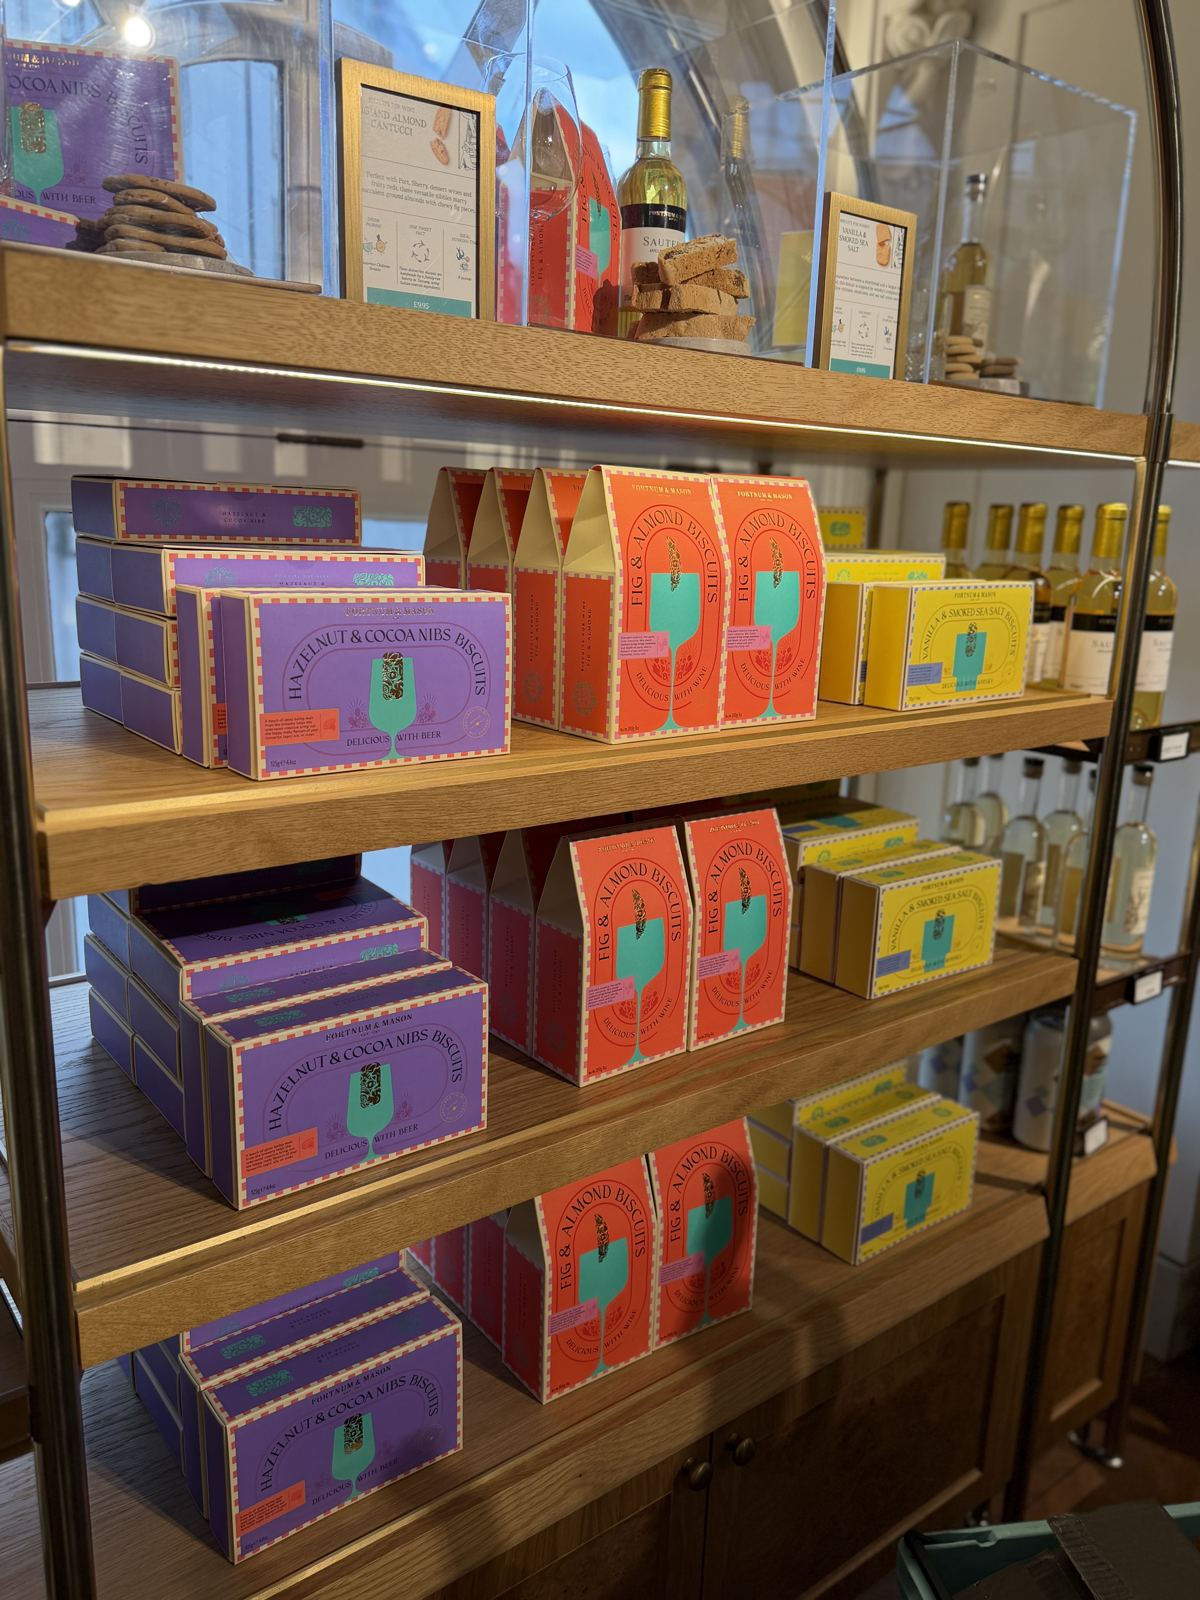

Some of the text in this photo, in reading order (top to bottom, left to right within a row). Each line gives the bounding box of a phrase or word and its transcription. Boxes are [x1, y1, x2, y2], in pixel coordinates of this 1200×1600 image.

[370, 119, 413, 136] CANTUCCI
[371, 109, 427, 128] AND ALMOND
[42, 192, 69, 202] WITH
[72, 194, 97, 204] BEER
[839, 235, 869, 247] SMOKED SEA
[842, 227, 863, 238] VANILLA
[847, 245, 860, 253] SALT
[632, 484, 665, 493] FORTNUM
[670, 487, 693, 495] MASON
[737, 490, 768, 498] FORTNUM
[772, 492, 793, 500] MASON
[630, 509, 719, 606] FIG & ALMOND BISCUITS
[737, 512, 816, 602] FIG & ALMOND BISCUITS
[922, 607, 1018, 660] VANILLA & SMOKED SEA SALT BISCUITS
[288, 628, 487, 701] HAZELNUT & COCOA NIBS BISCUITS
[635, 665, 708, 701] DELICIOUS WITH WINE
[740, 657, 806, 691] DELICIOUS WITH WINE
[346, 730, 442, 747] DELICIOUS WITH BEER
[710, 842, 753, 885] ALMOND
[708, 890, 719, 902] &
[756, 848, 782, 917] BISCUITS
[598, 862, 681, 961] FIG & ALMOND BISCUITS
[708, 908, 719, 933] FIG
[890, 911, 909, 951] VANILLA
[908, 903, 915, 913] &
[916, 896, 943, 909] SMOKED
[943, 893, 957, 903] SEA
[957, 889, 973, 898] SALT
[712, 971, 773, 1007] DELICIOUS WITH WINE
[325, 1013, 413, 1042] FORTNUM & MASON
[603, 999, 672, 1039] DELICIOUS WITH WINE
[268, 1029, 463, 1131] HAZELNUT & COCOA NIBS BISCUITS
[325, 1123, 419, 1160] DELICIOUS WITH BEER
[670, 1146, 749, 1242] FIG & ALMOND BISCUITS
[559, 1184, 646, 1291] FIG & ALMOND BISCUITS
[566, 1310, 637, 1355] DELICIOUS WITH WINE
[311, 1364, 392, 1405] FORTNUM & MASON
[260, 1374, 440, 1492] HAZELNUT & COCOA NIBS BISCUITS
[312, 1481, 352, 1506] DELICIOUS
[356, 1468, 378, 1483] WITH
